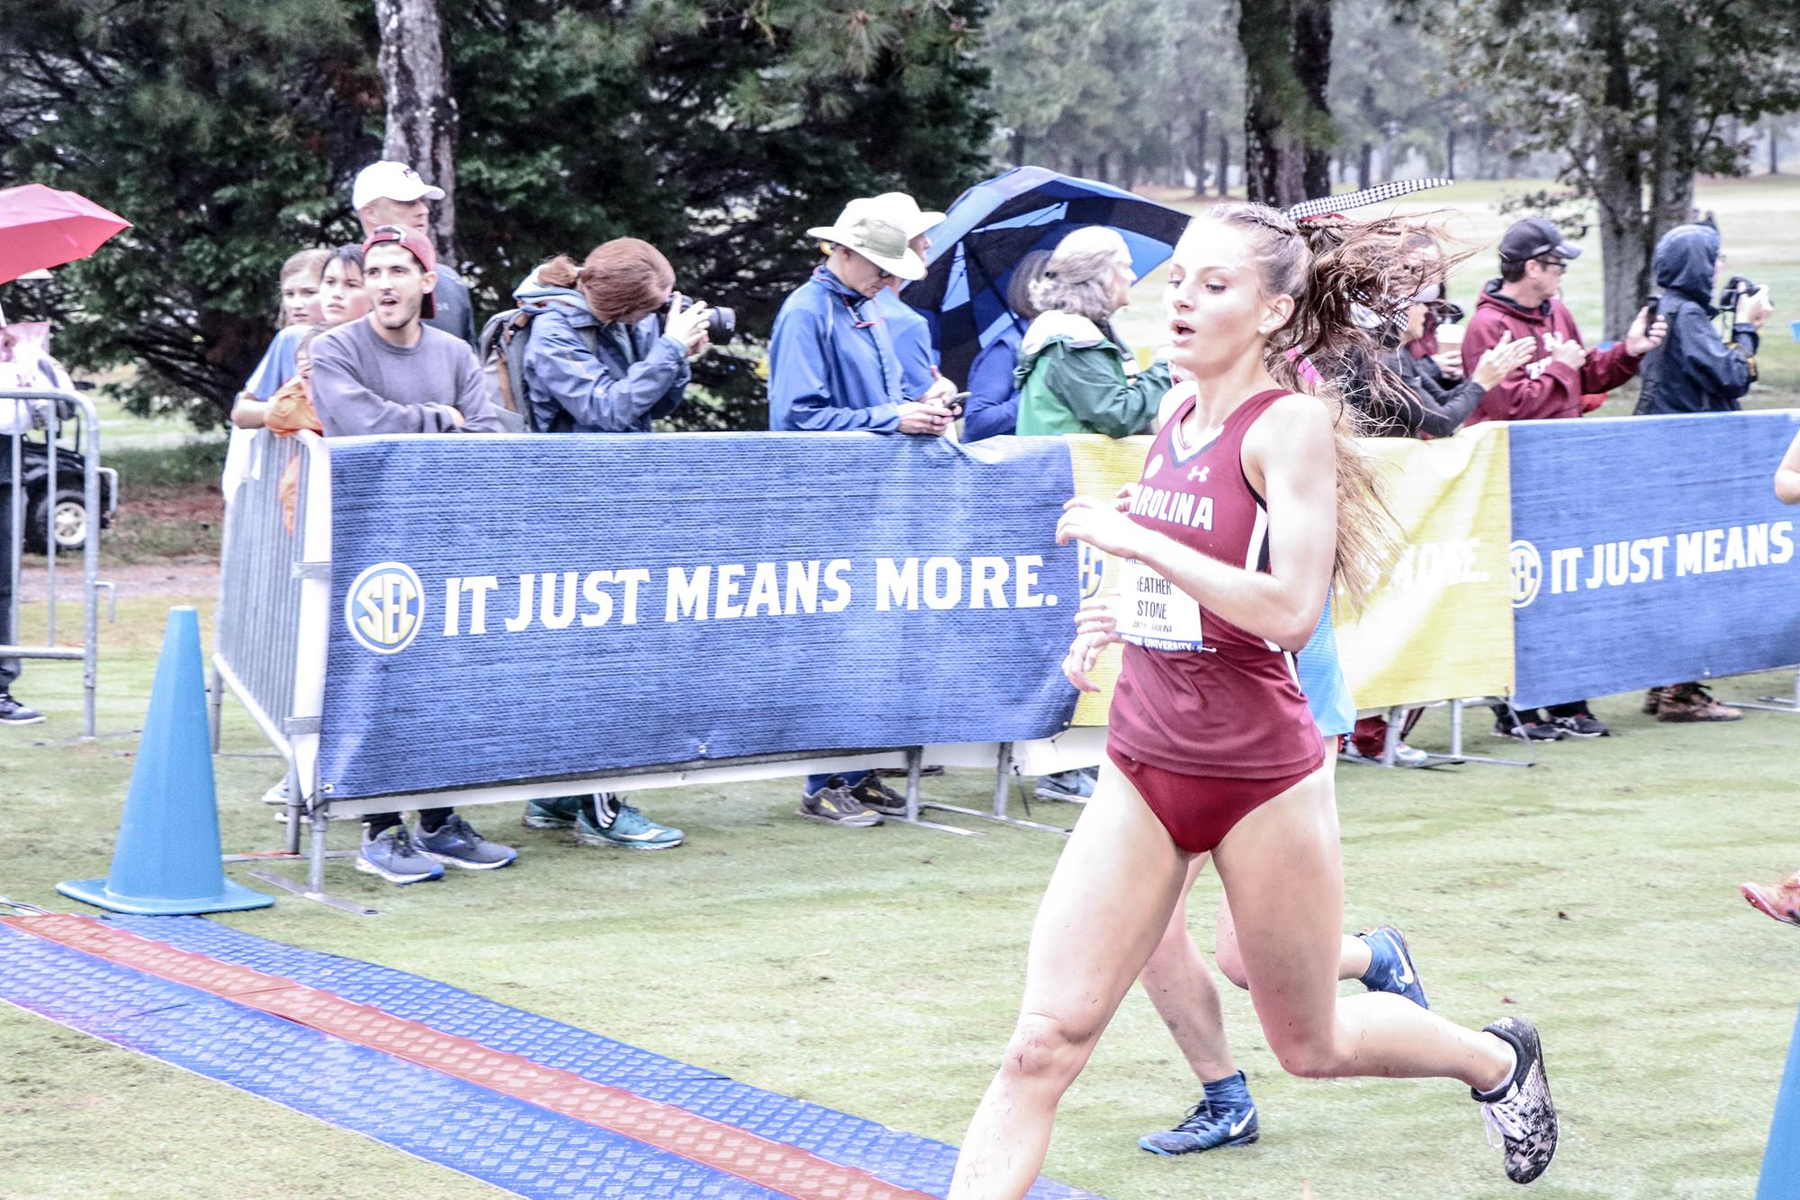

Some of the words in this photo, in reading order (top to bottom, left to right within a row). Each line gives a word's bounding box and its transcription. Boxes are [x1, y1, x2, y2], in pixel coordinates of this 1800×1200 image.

[1129, 484, 1214, 532] AROLINA
[1550, 546, 1584, 594] IT
[1586, 536, 1669, 590] JUST
[1676, 521, 1794, 577] MEANS
[354, 571, 418, 646] SEC
[443, 575, 499, 637] IT
[504, 568, 651, 632] JUST
[664, 558, 852, 622] MEANS
[875, 555, 1058, 612] MORE.
[1137, 600, 1168, 620] STONE
